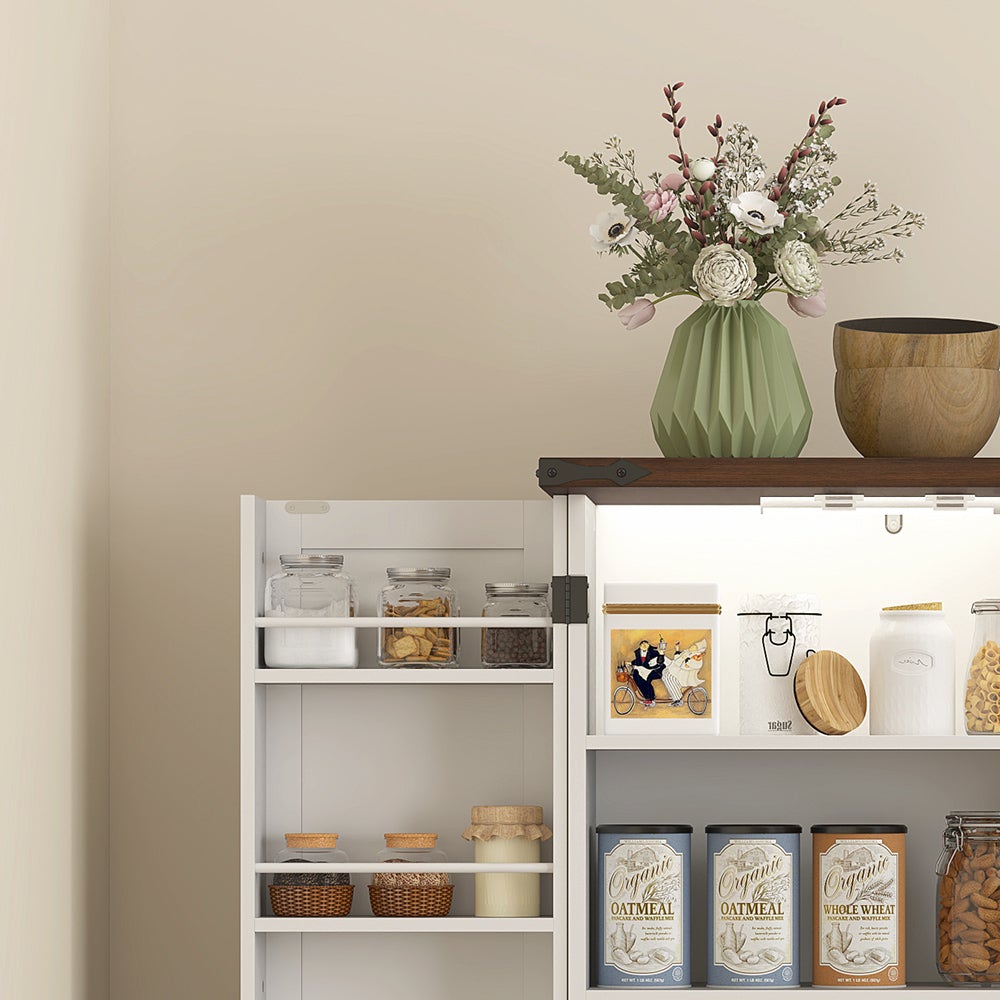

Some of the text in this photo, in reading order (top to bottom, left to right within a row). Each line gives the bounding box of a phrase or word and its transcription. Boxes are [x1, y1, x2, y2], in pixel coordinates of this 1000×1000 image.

[609, 855, 673, 900] Organic
[718, 855, 782, 900] Organic
[824, 855, 888, 900] Organic
[611, 902, 674, 915] OATMEAL
[721, 902, 784, 915] OATMEAL
[824, 904, 895, 915] WHOLE WHEAT
